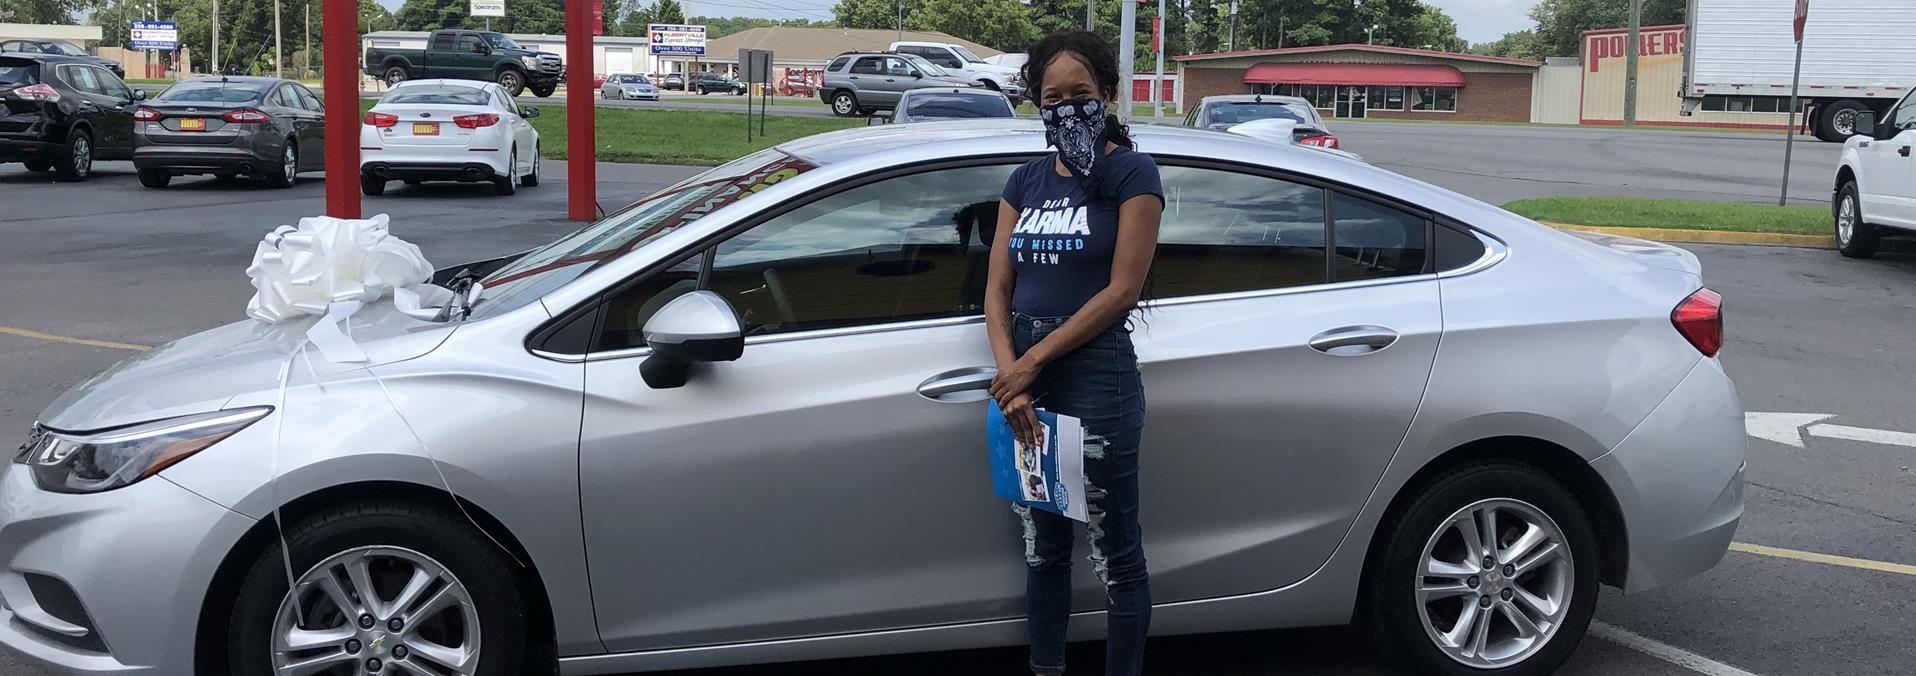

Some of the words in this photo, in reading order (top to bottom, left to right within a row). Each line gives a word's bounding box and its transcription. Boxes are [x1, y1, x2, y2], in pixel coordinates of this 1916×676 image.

[1012, 206, 1091, 235] KARMA
[1032, 239, 1083, 250] MISSED
[1017, 251, 1024, 262] A
[1033, 253, 1058, 264] FEW
